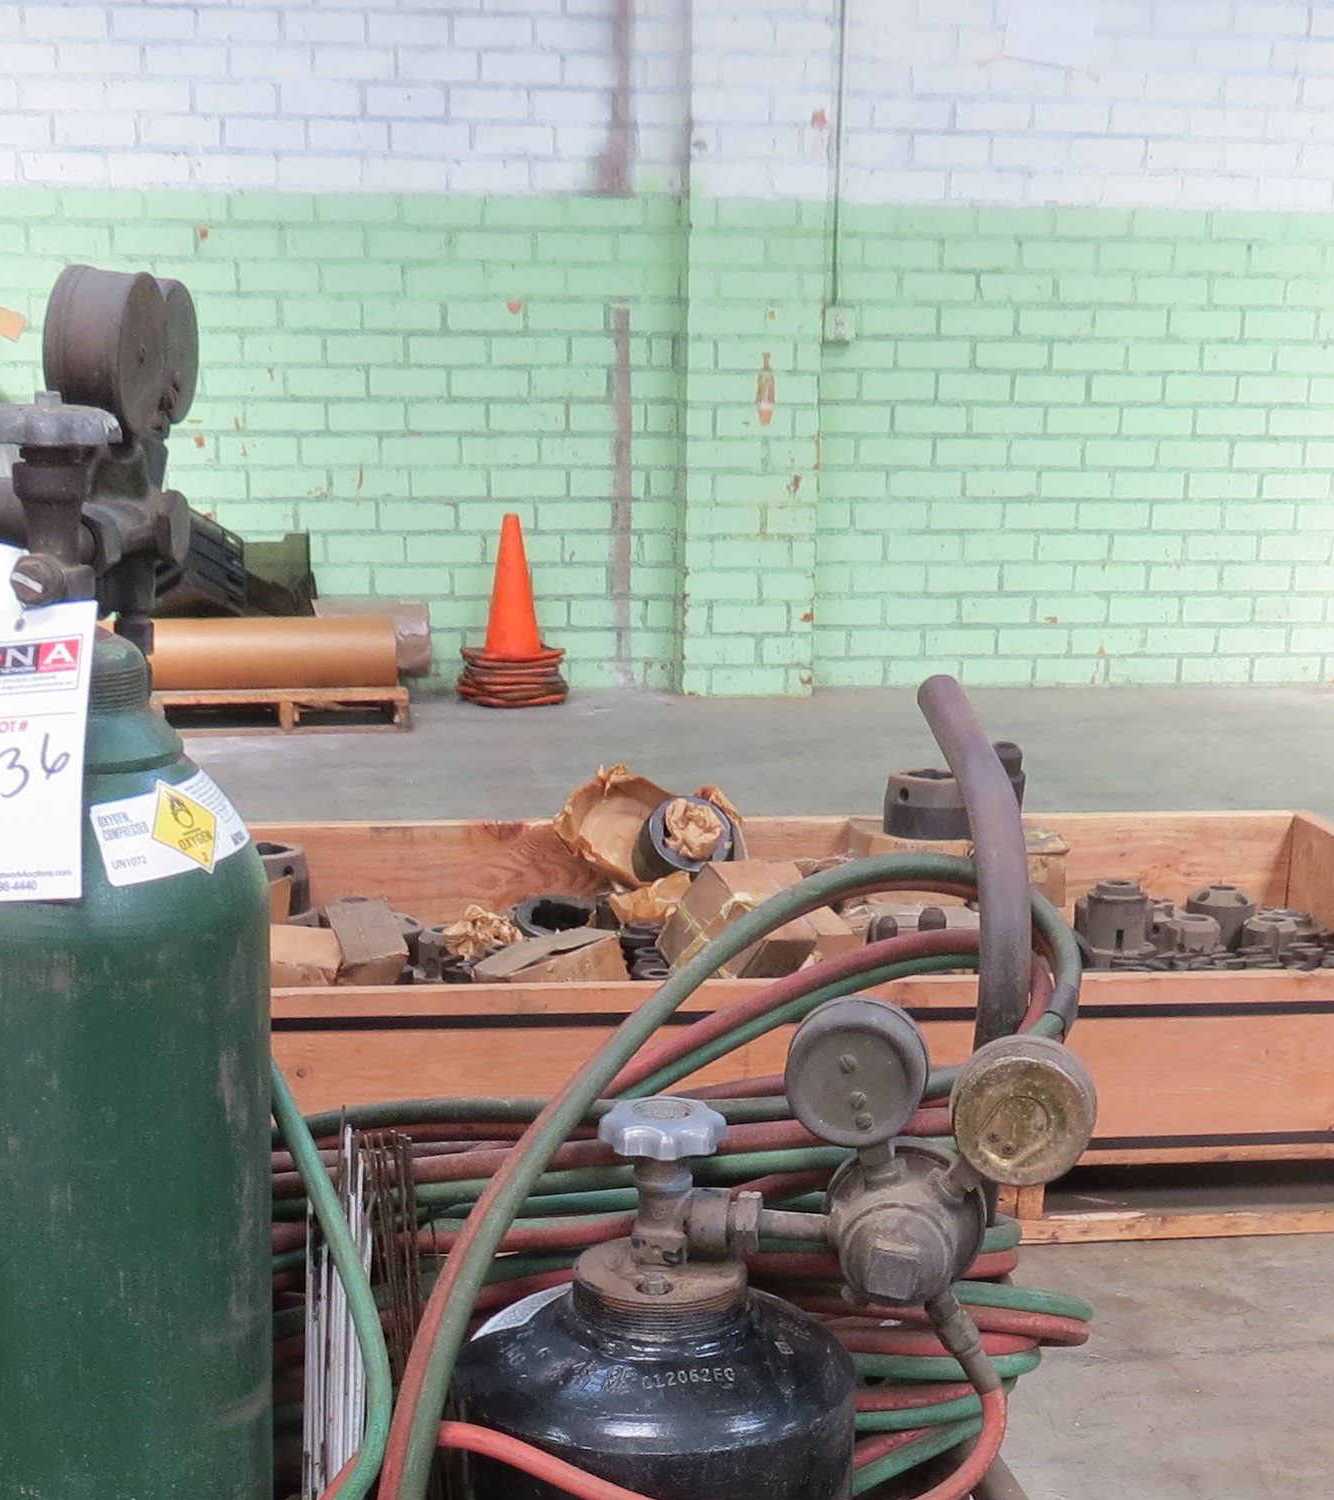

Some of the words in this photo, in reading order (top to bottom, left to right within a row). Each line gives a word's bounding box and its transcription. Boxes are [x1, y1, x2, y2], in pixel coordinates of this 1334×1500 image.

[17, 720, 28, 733] #
[177, 829, 214, 852] OXYGEN
[110, 854, 149, 870] UN1072
[200, 850, 210, 863] 2
